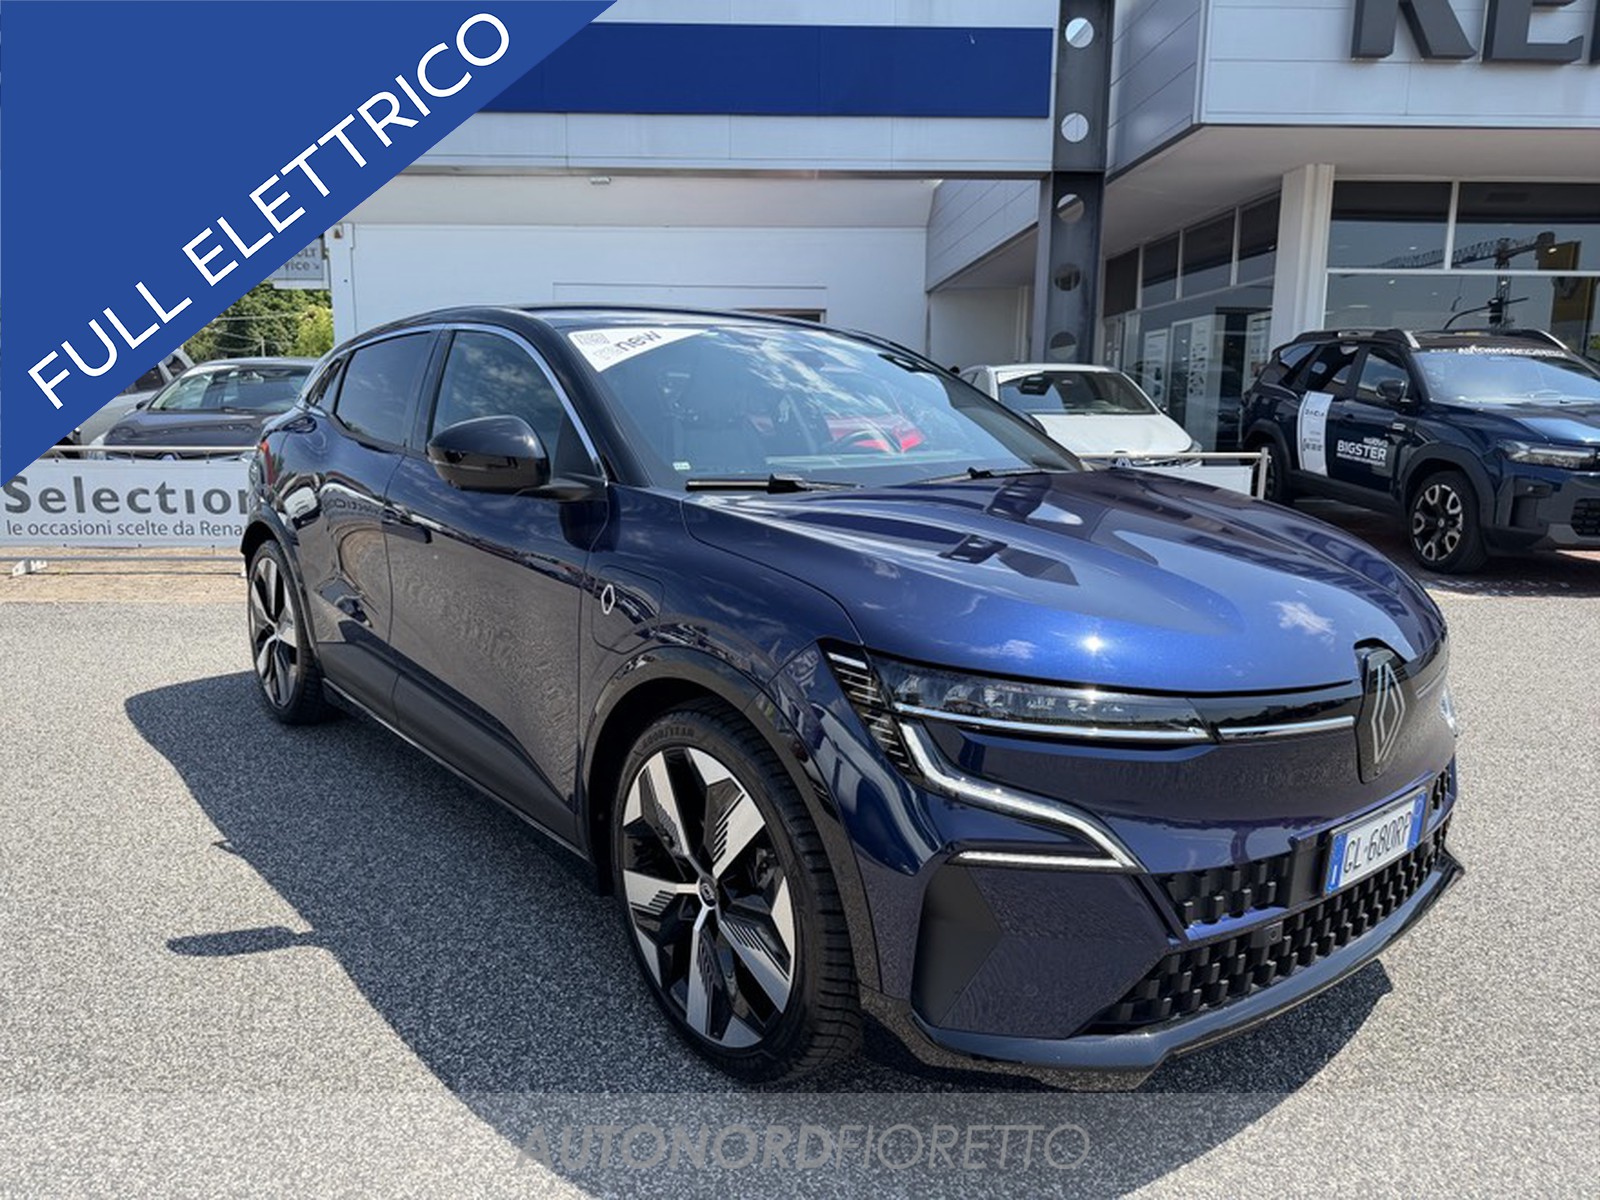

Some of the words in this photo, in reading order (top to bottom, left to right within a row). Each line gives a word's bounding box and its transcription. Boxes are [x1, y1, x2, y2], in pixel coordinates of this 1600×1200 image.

[614, 330, 662, 352] new
[1337, 439, 1387, 461] BIGSTER
[6, 520, 23, 536] le
[27, 520, 112, 536] occasioni
[117, 520, 168, 536] scelte
[173, 520, 195, 536] da
[200, 520, 246, 537] Rena
